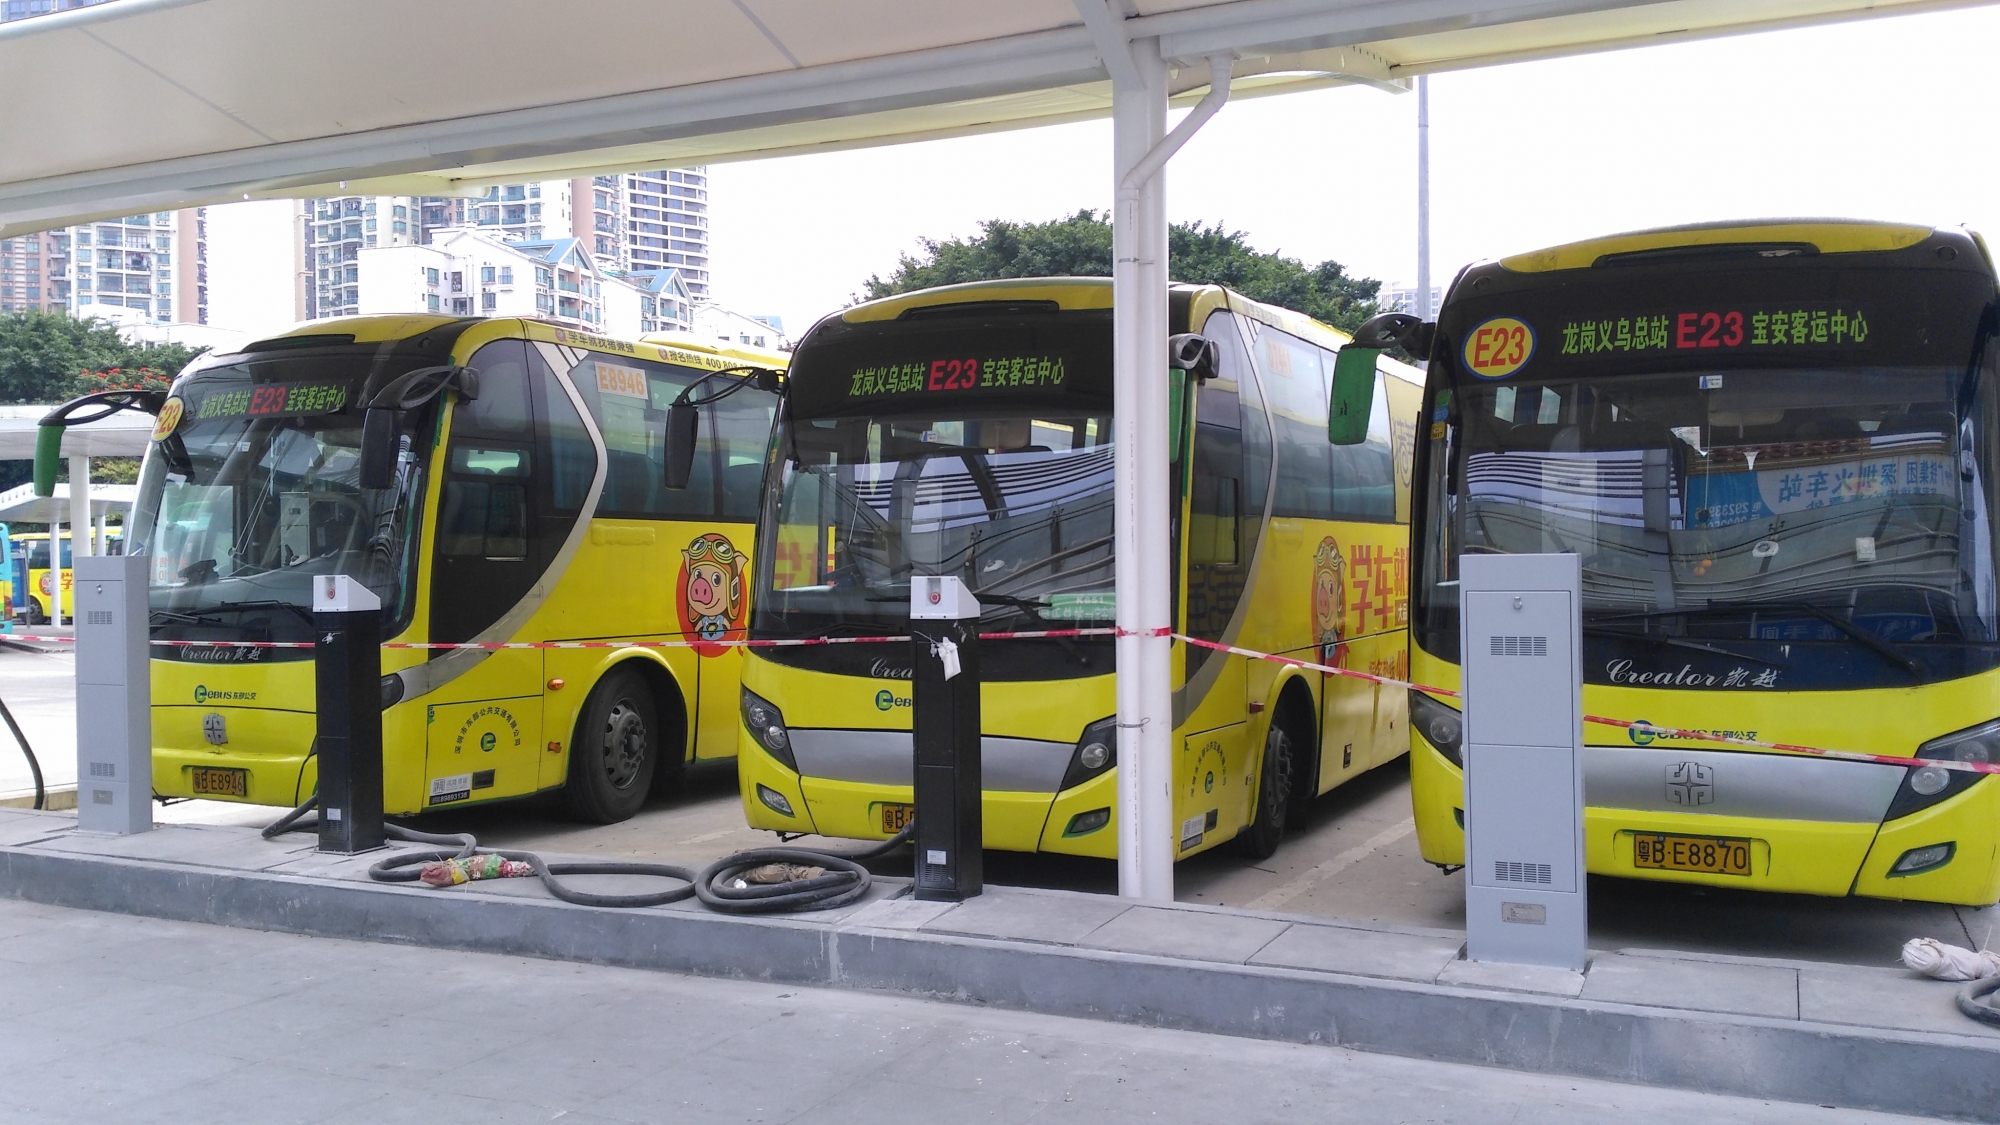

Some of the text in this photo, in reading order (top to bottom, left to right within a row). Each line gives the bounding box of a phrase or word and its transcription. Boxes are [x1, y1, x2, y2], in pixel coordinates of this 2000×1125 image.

[1474, 326, 1525, 368] E23
[1561, 309, 1869, 355] 龙岗义乌总站 E23 宝安客运中心
[669, 350, 702, 366] 报名热线
[705, 357, 722, 370] 400
[600, 366, 645, 396] E8946
[849, 356, 1065, 396] 龙岗义乌总站 E23 宝安客运中心
[249, 387, 287, 416] E23
[284, 385, 347, 412] 宝安客运中心
[154, 402, 182, 435] E23
[180, 644, 232, 660] Creator
[1396, 649, 1408, 681] 40
[1605, 658, 1779, 688] Creator 凯越
[453, 706, 521, 755] 深圳市东部公共交通有限公司
[1711, 729, 1758, 742] 东部公交
